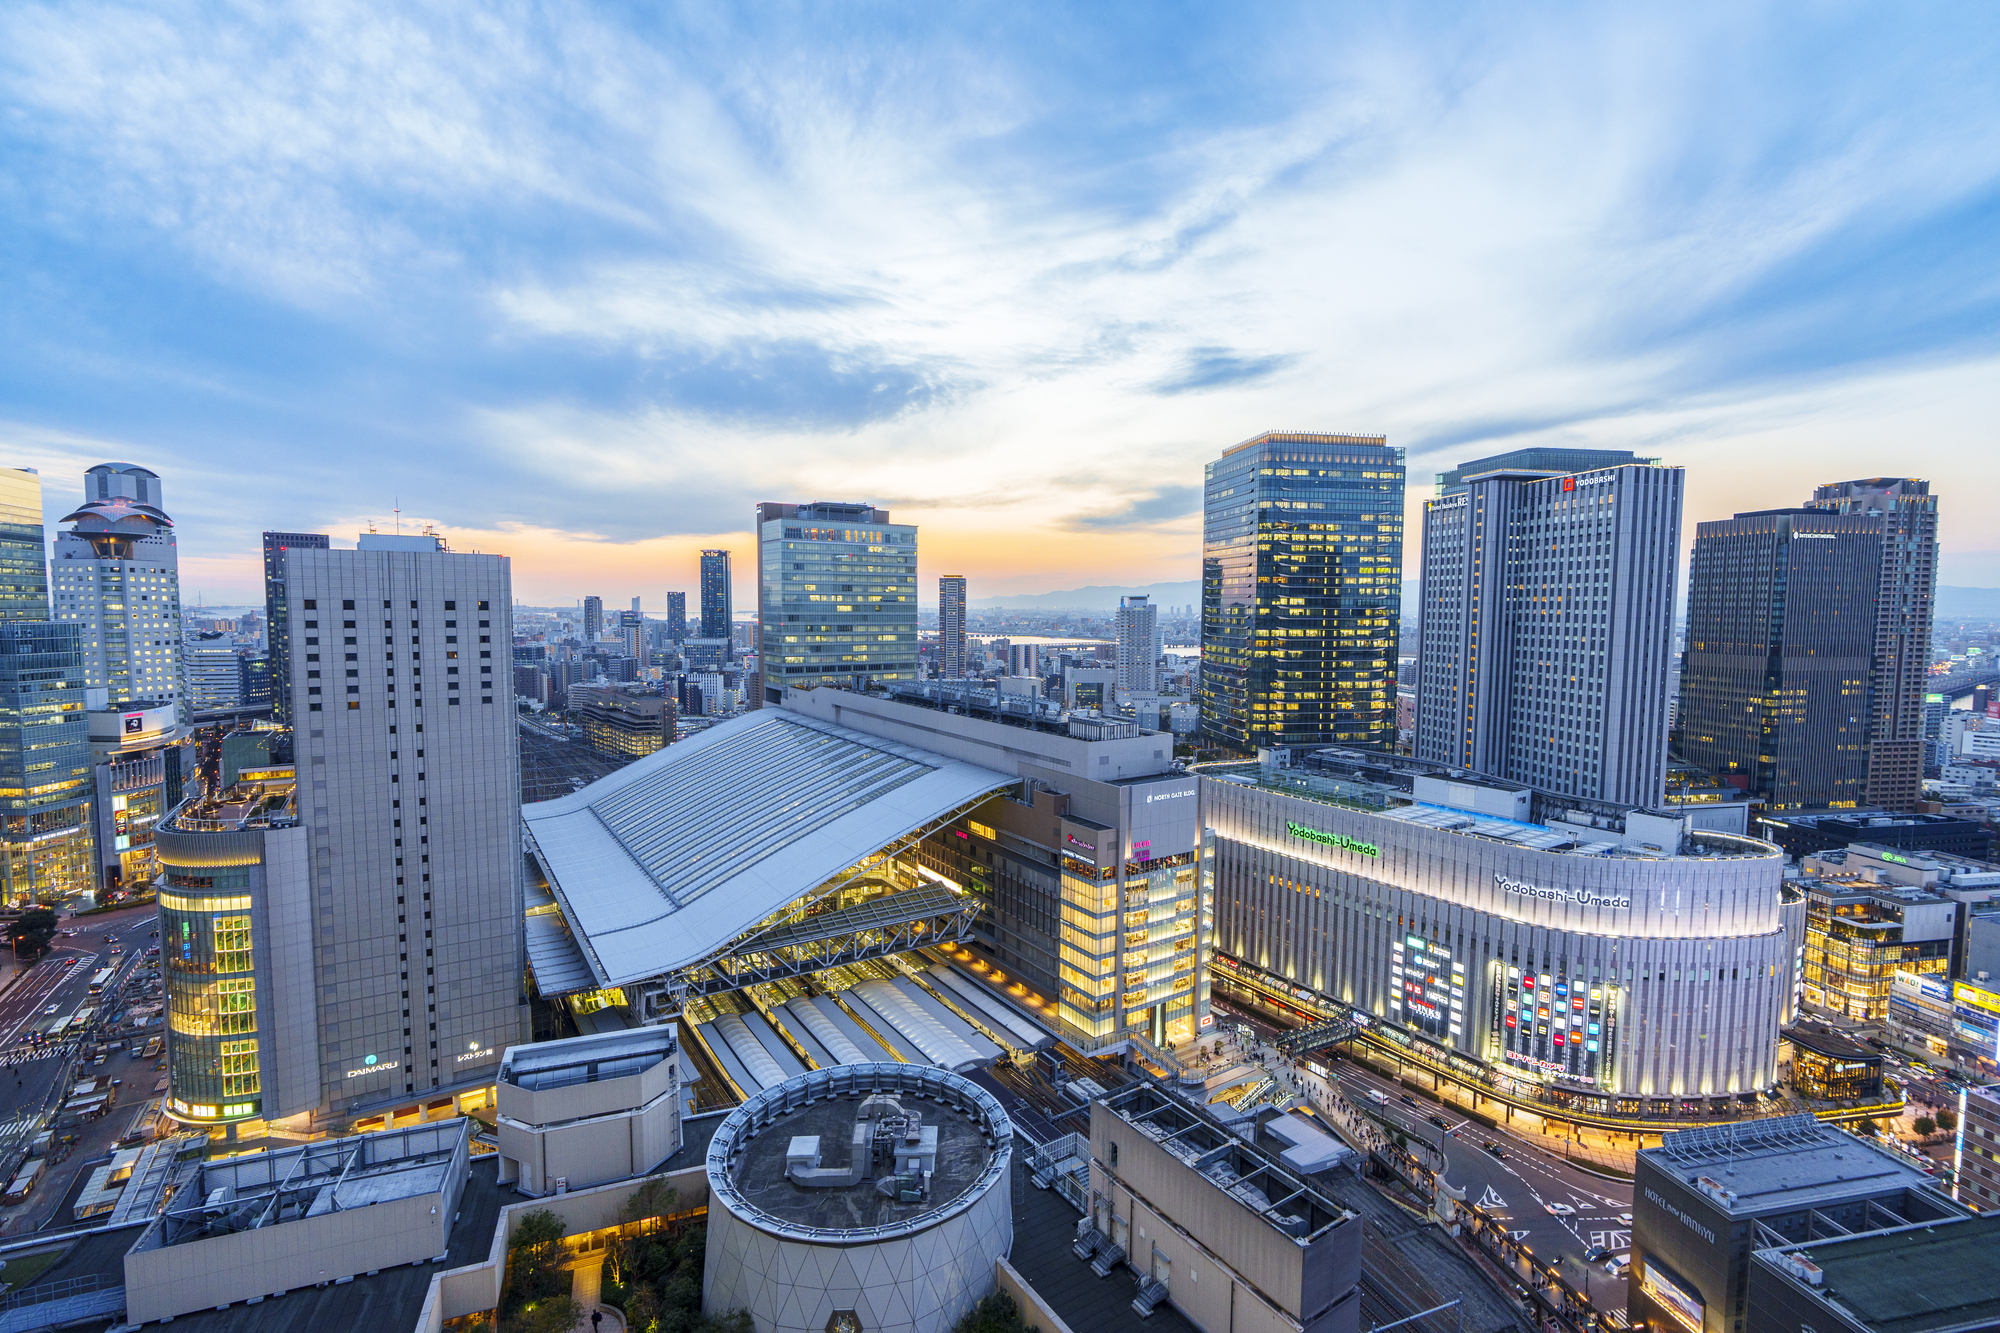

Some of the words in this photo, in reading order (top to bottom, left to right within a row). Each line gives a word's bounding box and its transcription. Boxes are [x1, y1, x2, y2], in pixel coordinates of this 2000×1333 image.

[1575, 475, 1616, 487] YODOBASHI
[1287, 823, 1377, 856] Yodobashi-Umeda
[1494, 875, 1630, 908] Yodobashi-Umeda
[347, 1061, 399, 1079] DAIMARU
[1506, 1049, 1566, 1072] ヨドバシカメラ
[1645, 1186, 1667, 1211] HOTEL
[1680, 1211, 1715, 1245] HANKYU
